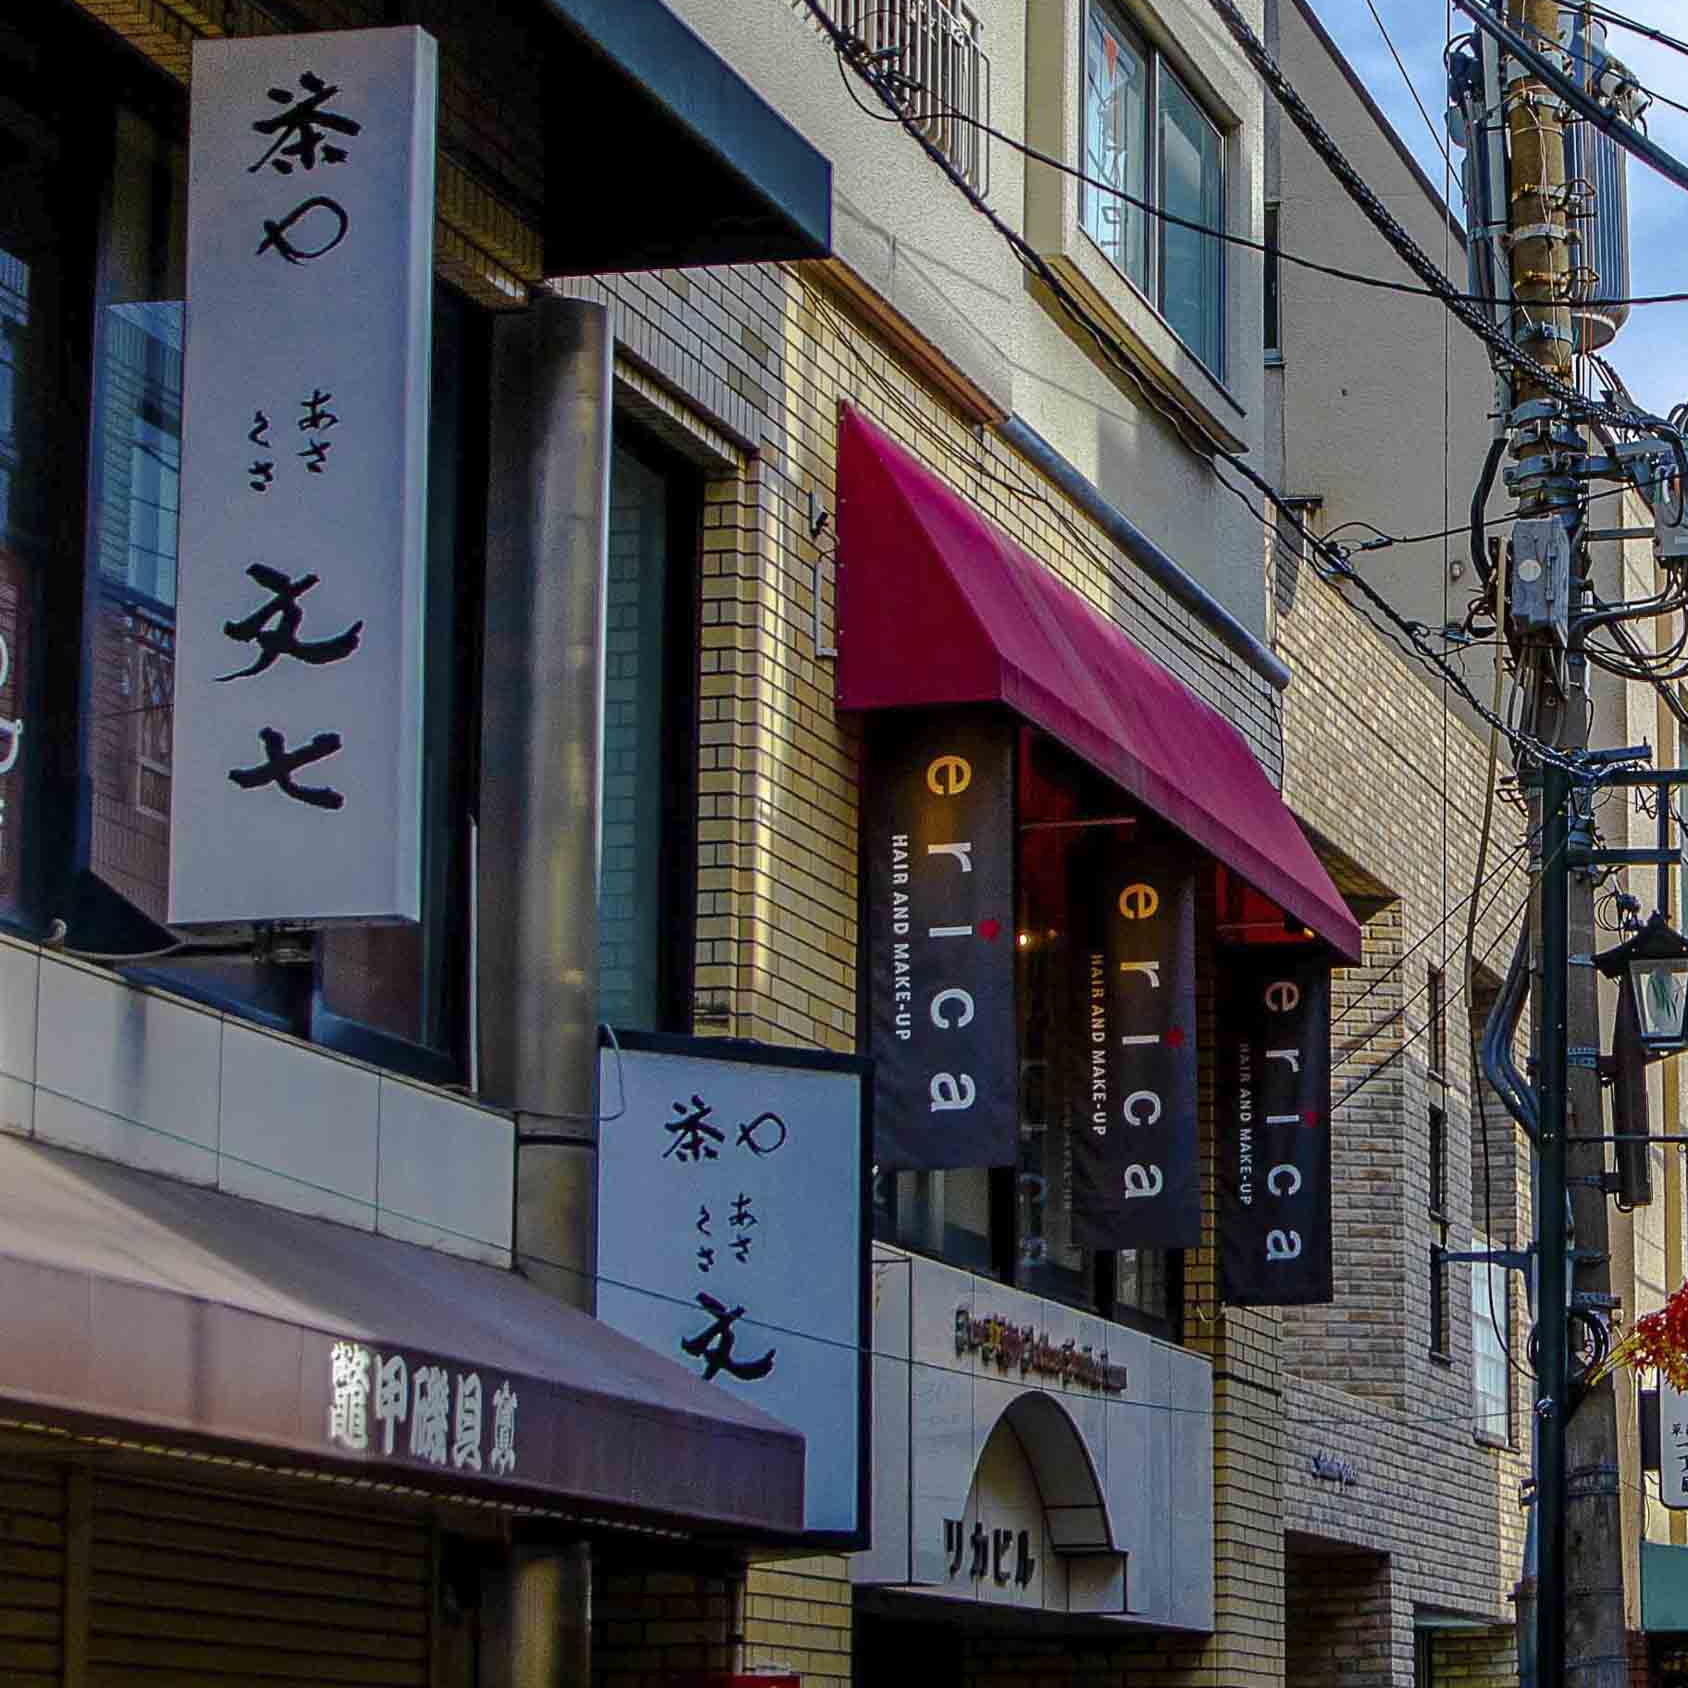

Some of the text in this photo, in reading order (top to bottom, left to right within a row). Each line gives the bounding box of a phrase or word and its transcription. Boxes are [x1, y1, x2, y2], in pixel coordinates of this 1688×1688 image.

[890, 833, 911, 1040] HAIR AND MAKE-UP
[927, 755, 1000, 1112] erica
[1089, 953, 1107, 1136] HAIR AND MAKE-UP
[1119, 882, 1185, 1200] erica
[1265, 981, 1318, 1262] erica
